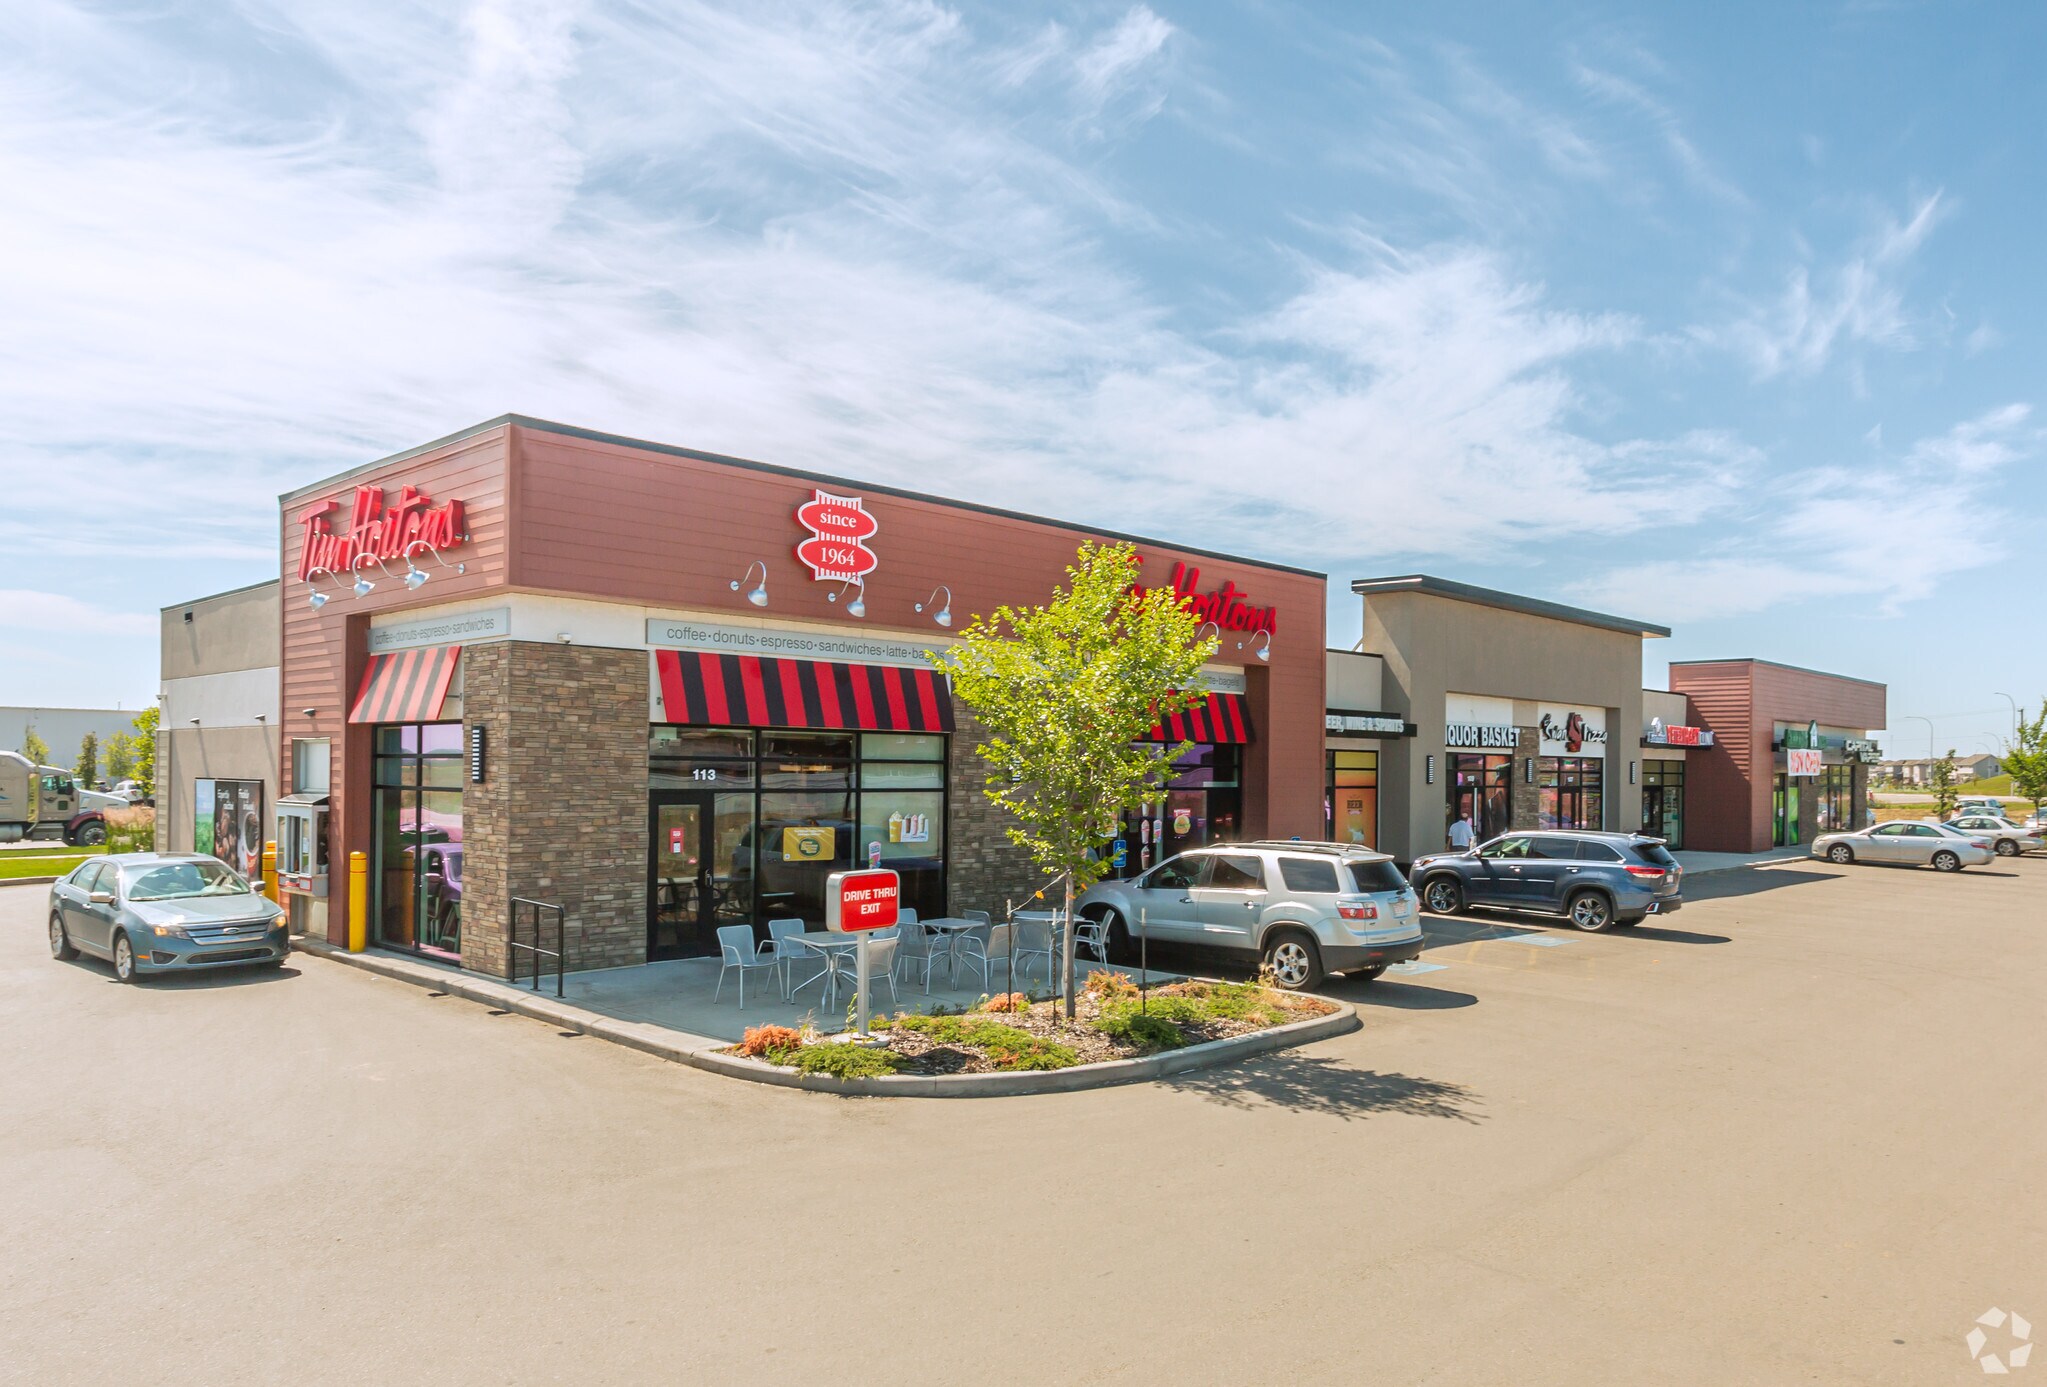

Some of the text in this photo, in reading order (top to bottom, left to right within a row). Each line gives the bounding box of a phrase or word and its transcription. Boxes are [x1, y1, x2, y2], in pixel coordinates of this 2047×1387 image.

[820, 508, 857, 528] since
[297, 484, 465, 582] Tim Hortons
[821, 547, 855, 566] 1964
[1169, 561, 1277, 636] Hortons
[1445, 725, 1520, 747] IQUOR BASKET
[693, 768, 716, 780] 113
[844, 887, 897, 902] DRIVE THRU
[860, 902, 881, 915] EXIT
